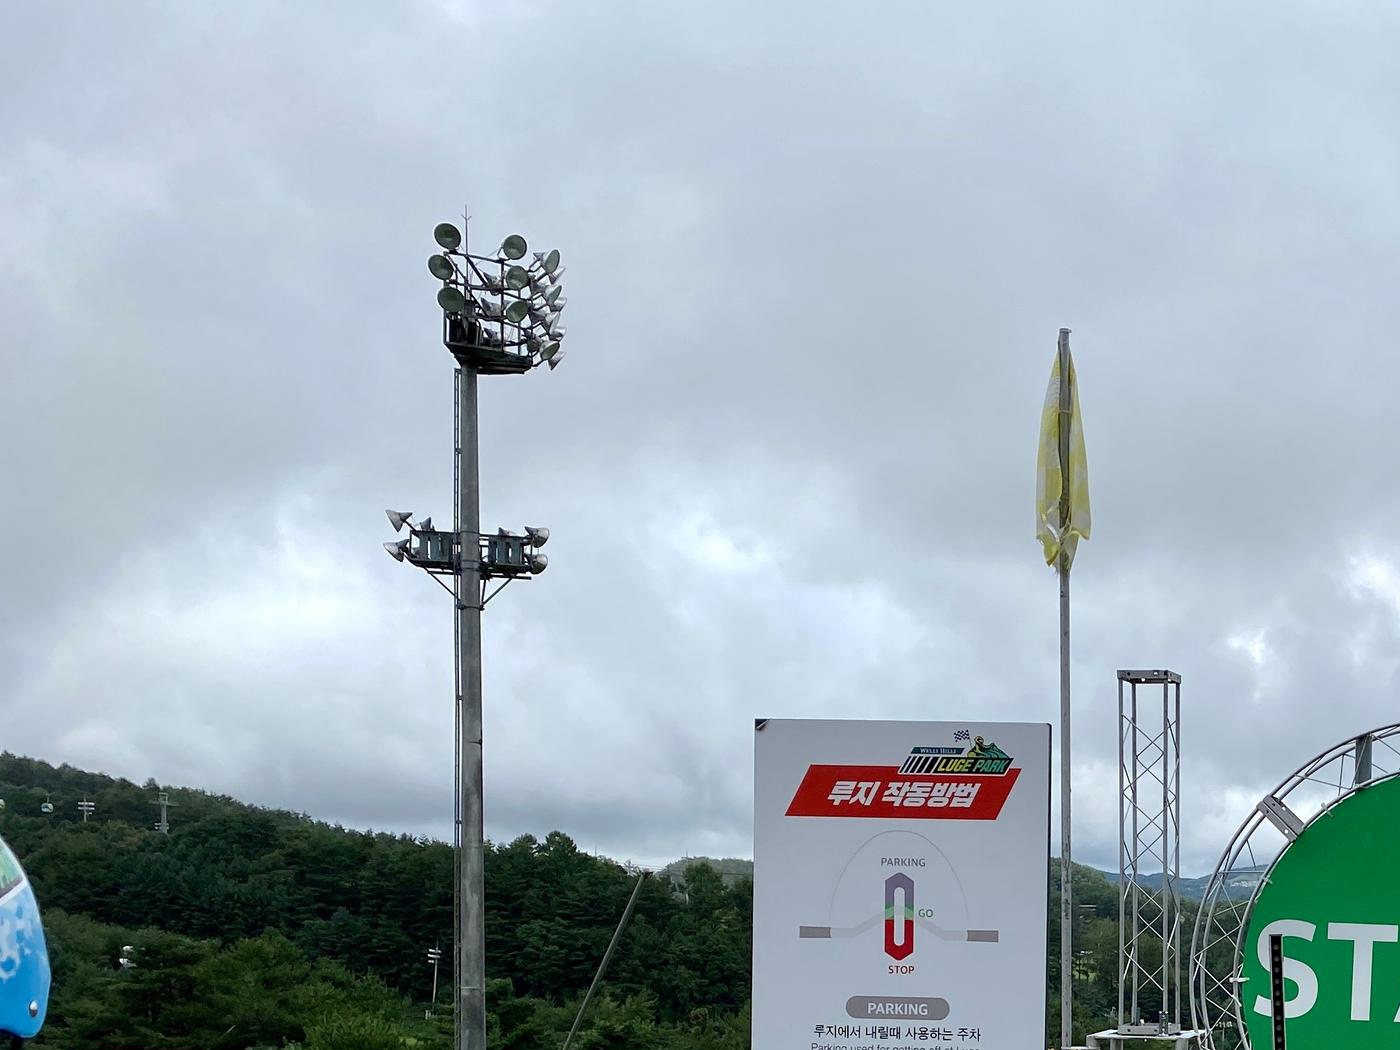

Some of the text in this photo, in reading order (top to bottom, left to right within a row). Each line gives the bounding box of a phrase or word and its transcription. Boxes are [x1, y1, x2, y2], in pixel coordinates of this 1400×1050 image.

[937, 758, 1009, 773] LUGE PARK
[827, 780, 982, 808] 루지 작동방법
[880, 857, 926, 868] PARKING
[918, 908, 934, 918] GO
[888, 964, 915, 975] STOP
[867, 1001, 928, 1016] PARKING
[813, 1024, 981, 1042] 루지에서 내릴때 사용하는 주차
